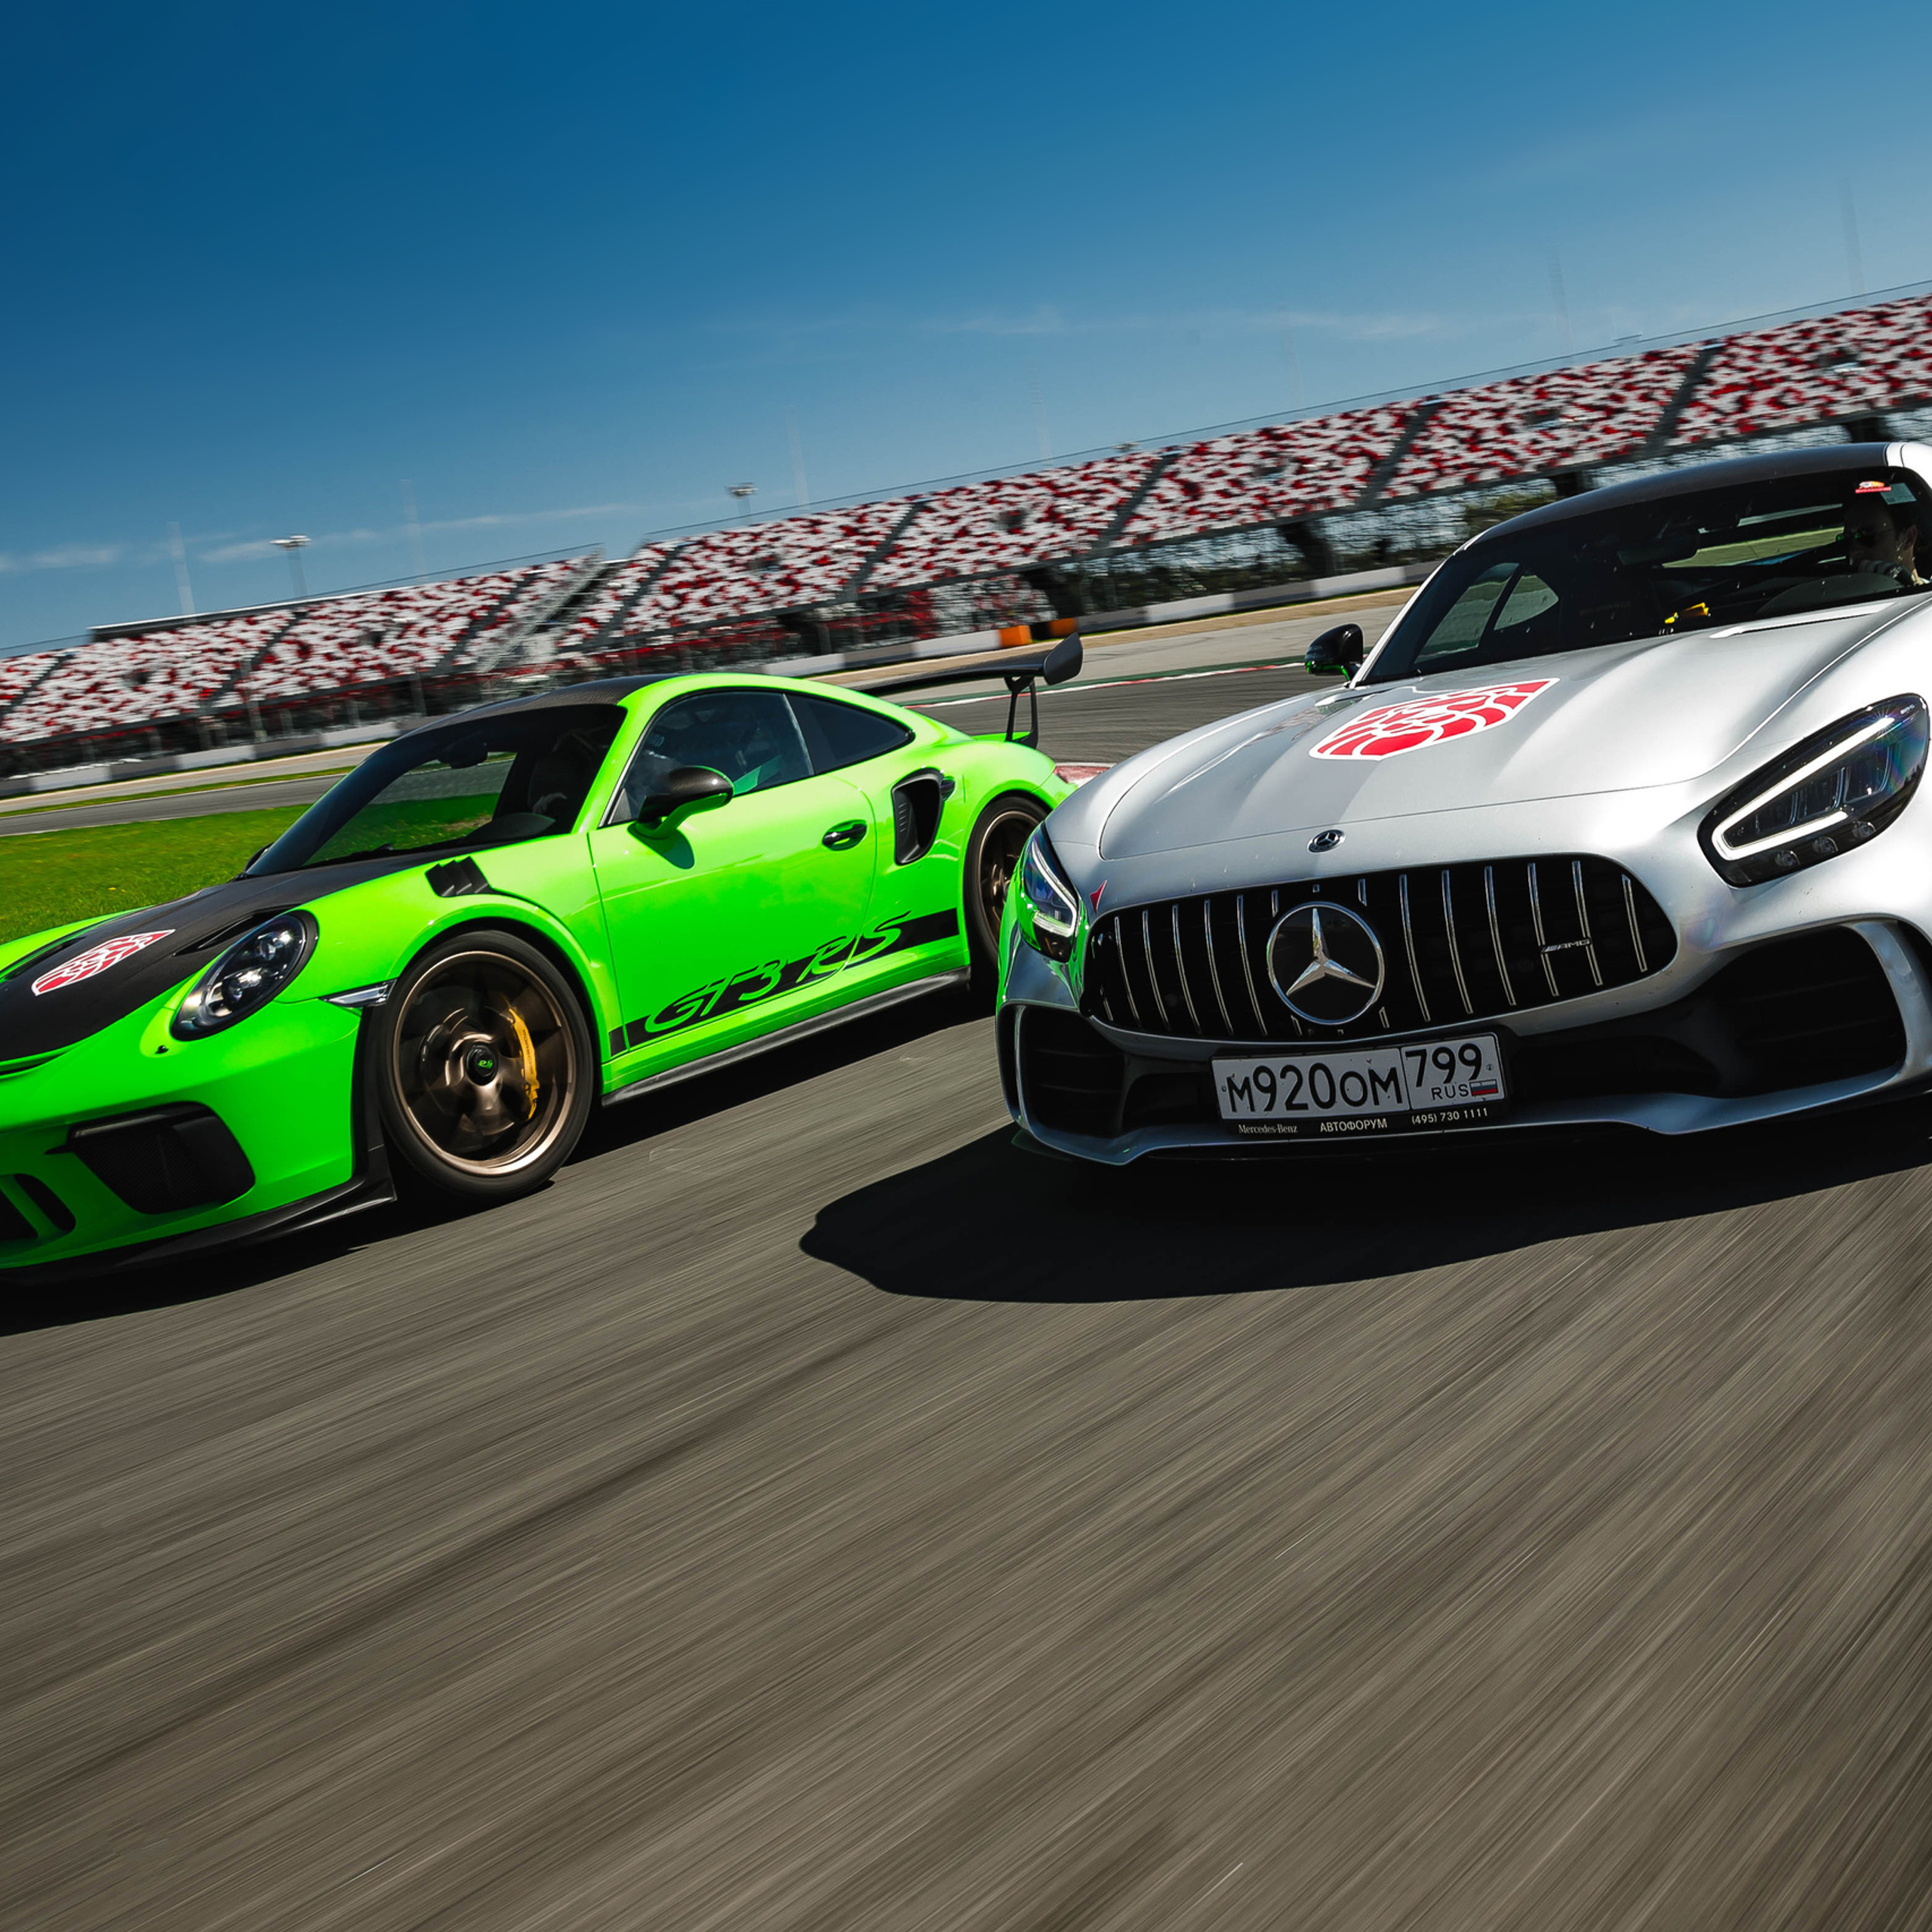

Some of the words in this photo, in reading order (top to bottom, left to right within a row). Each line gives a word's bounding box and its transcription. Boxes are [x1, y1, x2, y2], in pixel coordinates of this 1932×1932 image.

[645, 958, 788, 1033] GT3
[796, 911, 912, 983] RS
[1405, 1043, 1483, 1088] 799
[1431, 1083, 1469, 1101] RUS
[1411, 1113, 1438, 1124] (495)
[1440, 1111, 1460, 1121] 730
[1463, 1107, 1488, 1118] 1111
[1238, 1123, 1298, 1134] Mercedes-Benz
[1320, 1118, 1388, 1133] АВТОФОРУМ
